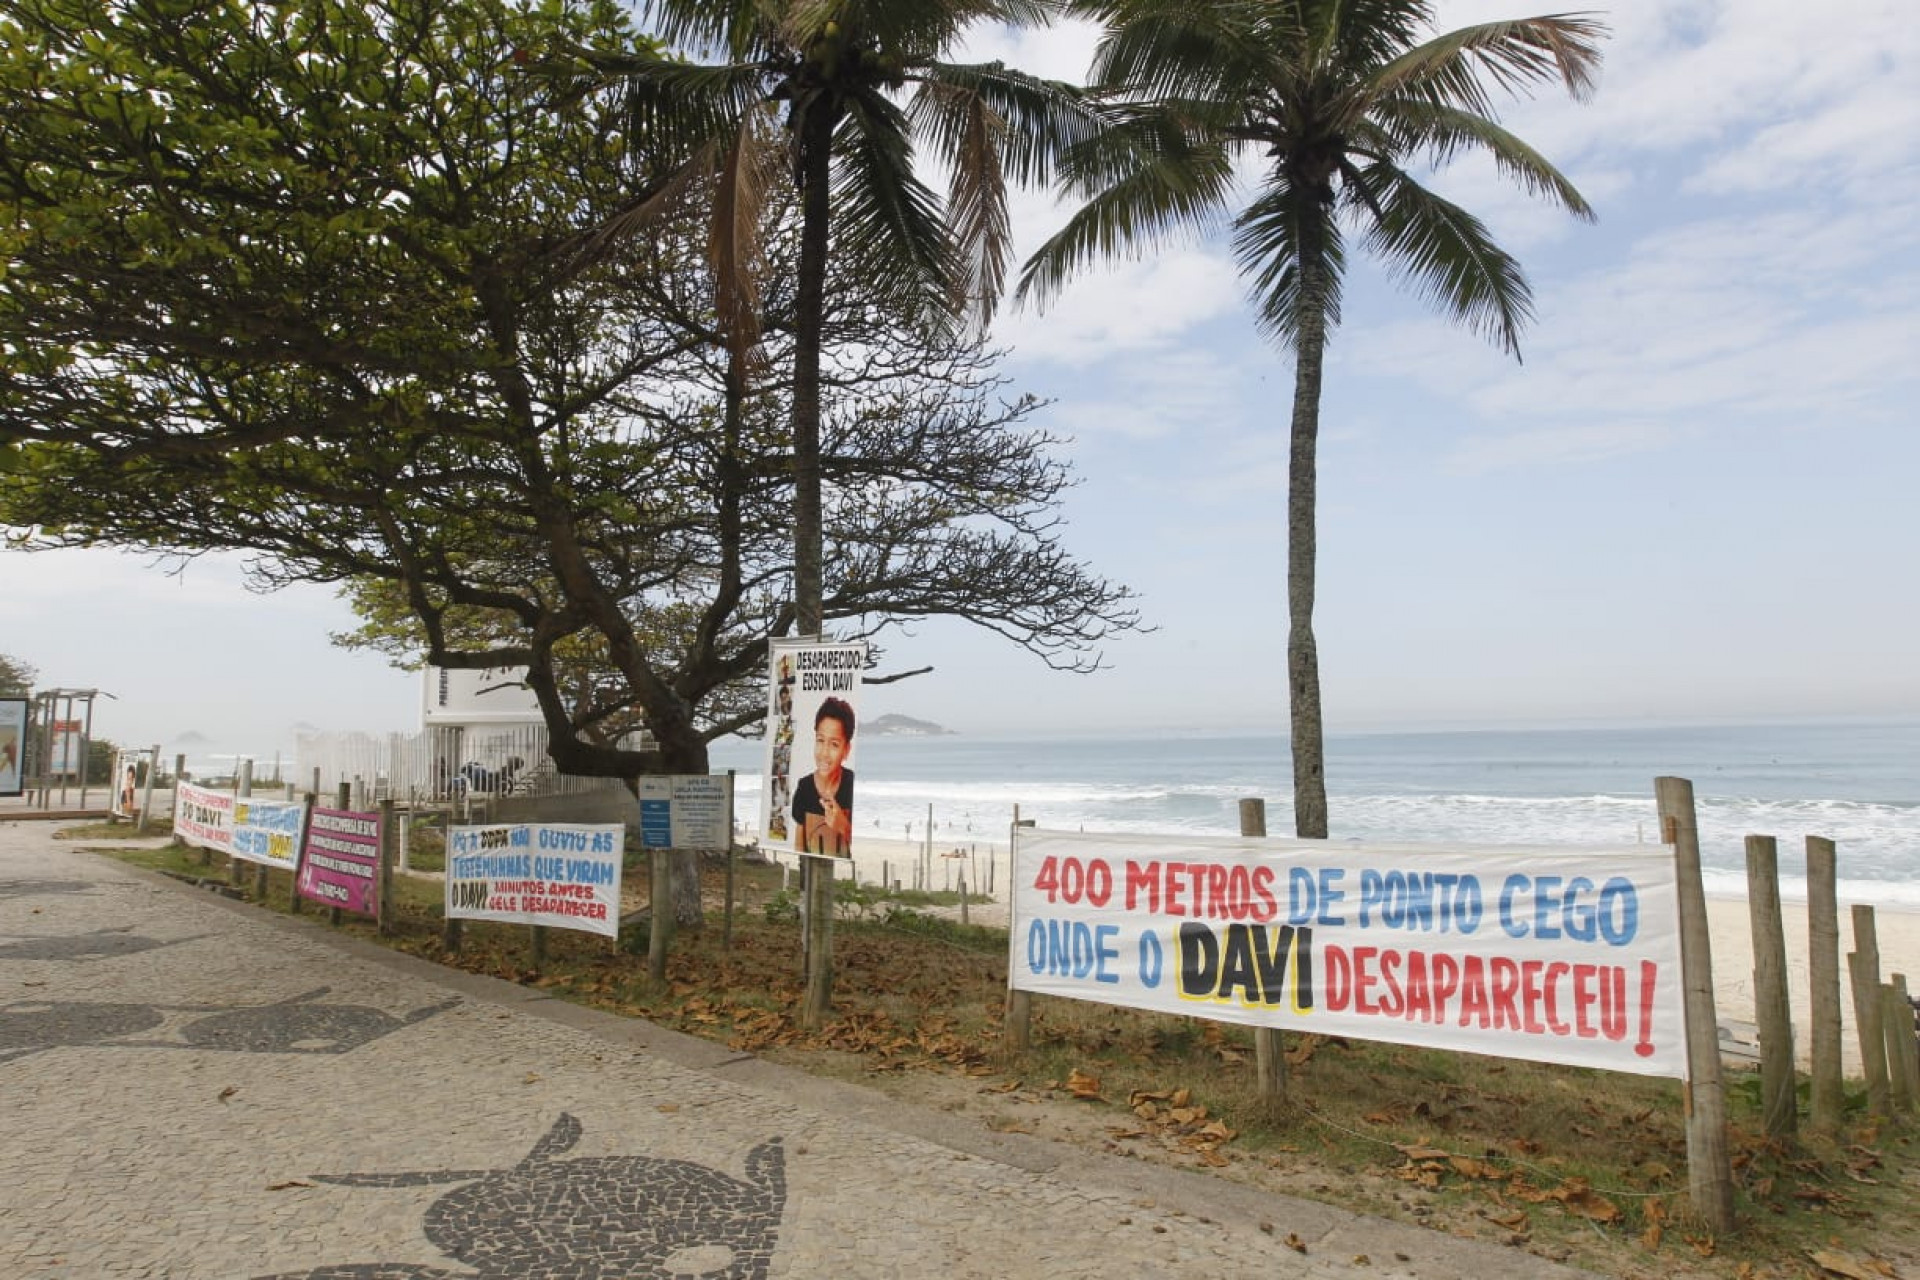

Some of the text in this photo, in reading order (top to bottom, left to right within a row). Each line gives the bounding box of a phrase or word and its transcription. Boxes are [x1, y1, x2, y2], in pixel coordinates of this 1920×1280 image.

[796, 651, 862, 671] DESAPARECIDO:
[802, 673, 853, 691] EDSON DAVI
[539, 829, 587, 853] OUVIU
[592, 832, 613, 853] AS
[534, 855, 564, 881] QUE
[567, 862, 614, 886] VIRAM
[452, 881, 594, 910] O DAVI MINUTOS ANTES
[521, 896, 607, 921] DESAPARECER
[1034, 854, 1639, 947] 400 METROS DE PONTO CEGO
[1027, 918, 1658, 1057] ONDE O DAVI DESAPARECEU!
